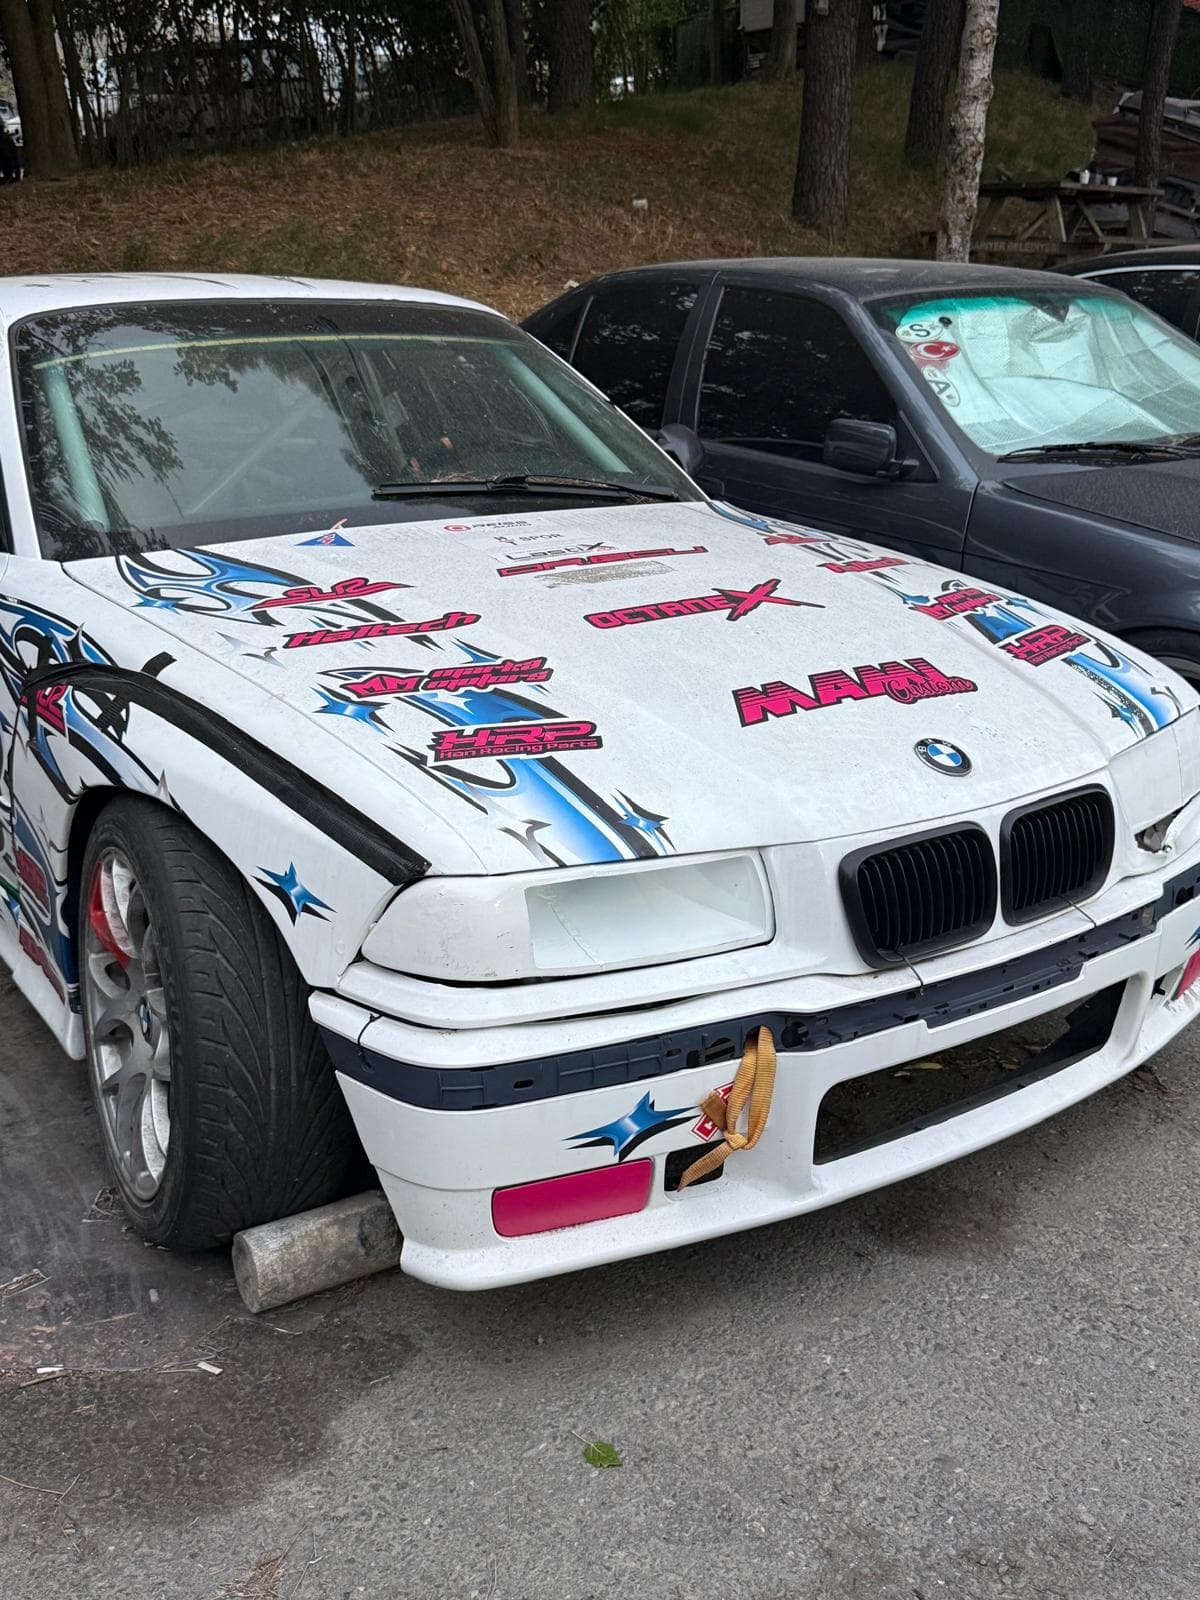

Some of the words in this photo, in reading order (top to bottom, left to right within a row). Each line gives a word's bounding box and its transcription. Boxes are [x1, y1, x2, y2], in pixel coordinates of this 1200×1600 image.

[909, 324, 931, 337] S
[928, 379, 951, 395] A
[519, 533, 564, 542] SPOR
[284, 612, 481, 648] Haltech
[886, 676, 978, 704] Custom
[434, 721, 596, 750] HRP
[440, 750, 477, 759] Han
[480, 744, 543, 756] Racing
[548, 740, 598, 749] Parts
